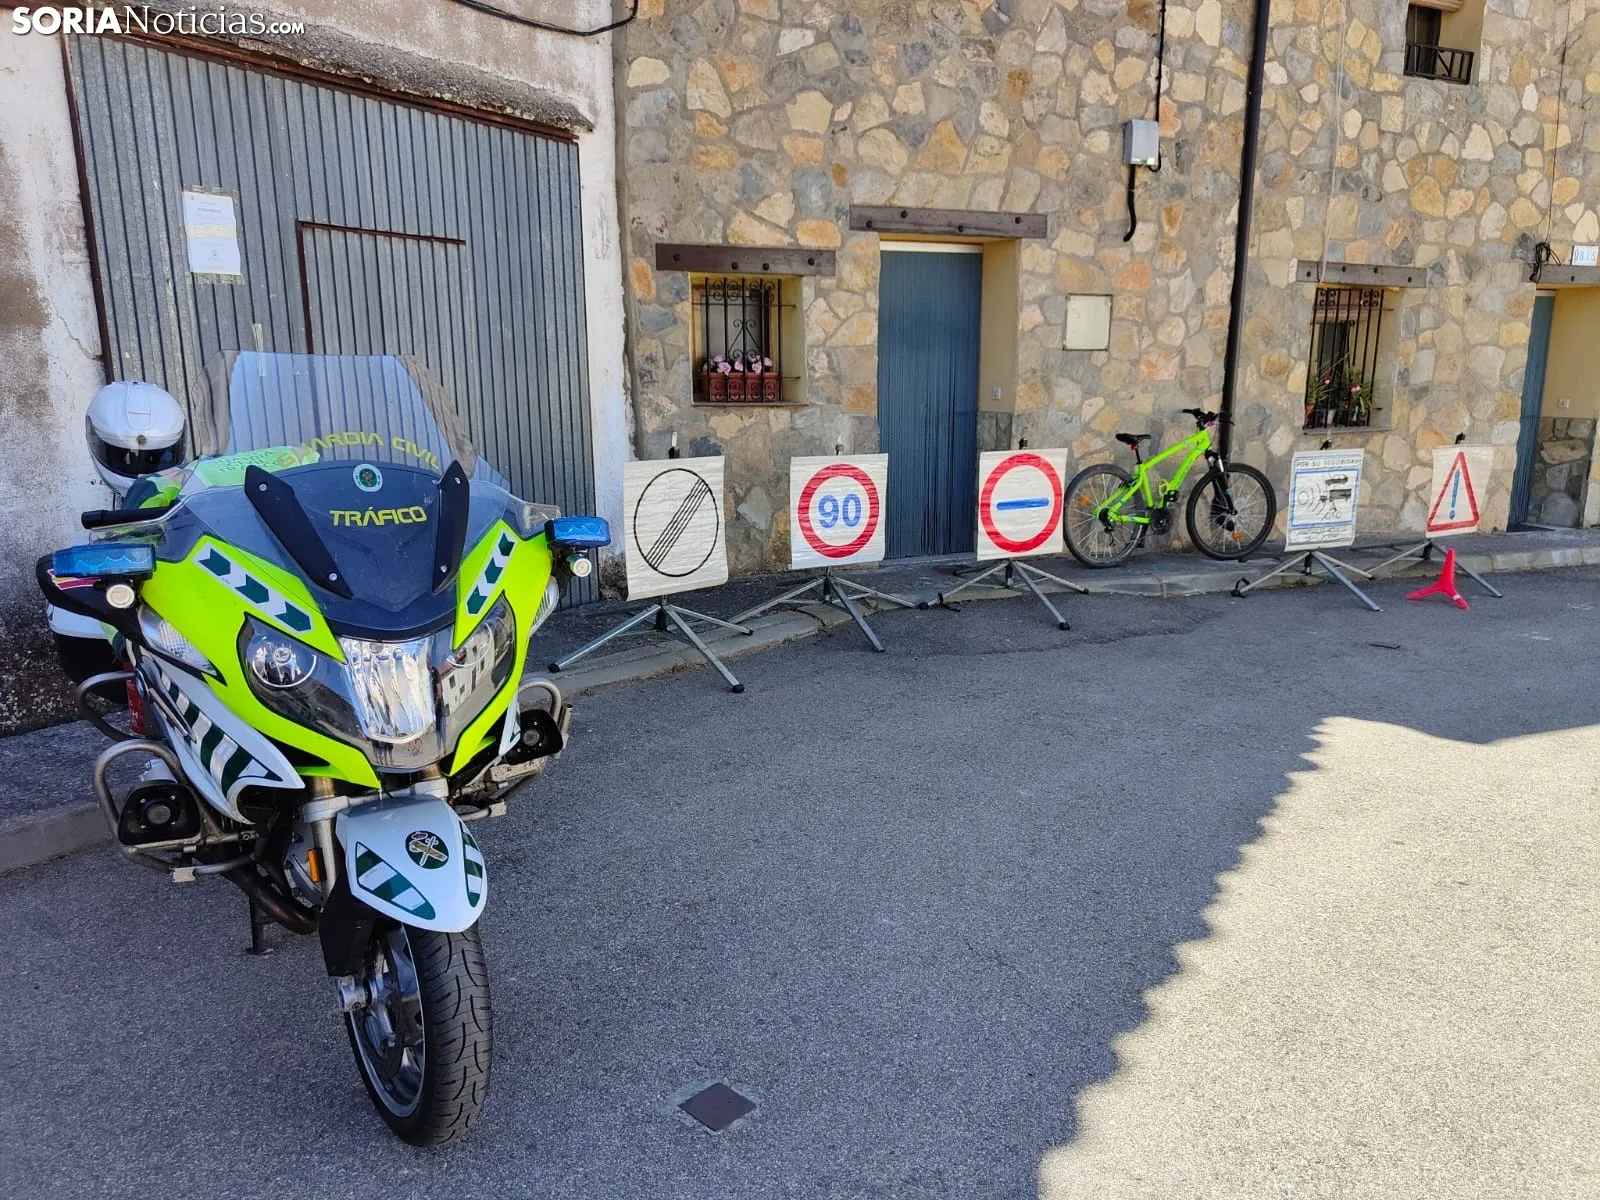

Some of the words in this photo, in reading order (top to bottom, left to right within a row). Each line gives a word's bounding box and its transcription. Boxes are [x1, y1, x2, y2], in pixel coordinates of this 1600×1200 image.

[392, 436, 440, 470] CIVIL
[329, 506, 428, 527] TRÁFICO
[818, 493, 862, 529] 90
